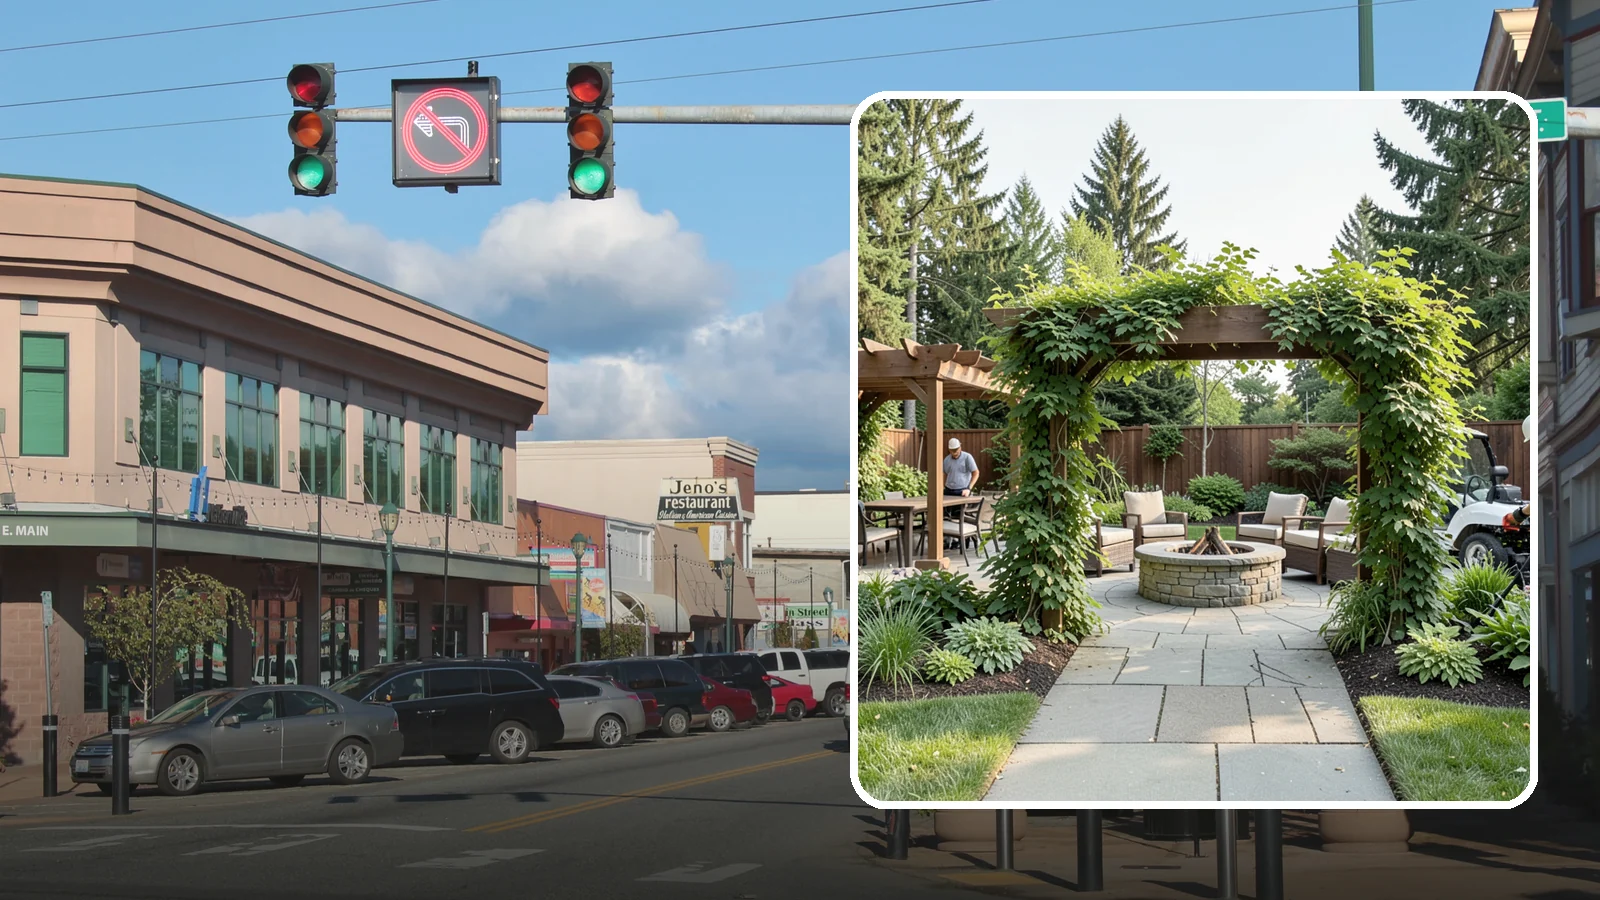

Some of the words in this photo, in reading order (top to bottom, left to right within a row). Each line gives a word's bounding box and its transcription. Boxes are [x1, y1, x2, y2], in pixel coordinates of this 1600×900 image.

[670, 480, 727, 494] Jeno's
[665, 496, 731, 509] restaurant
[659, 510, 681, 519] Italian
[686, 510, 714, 519] American
[715, 509, 737, 519] Cuisine
[2, 525, 13, 536] E.
[15, 525, 49, 536] MAIN
[797, 608, 828, 616] Street
